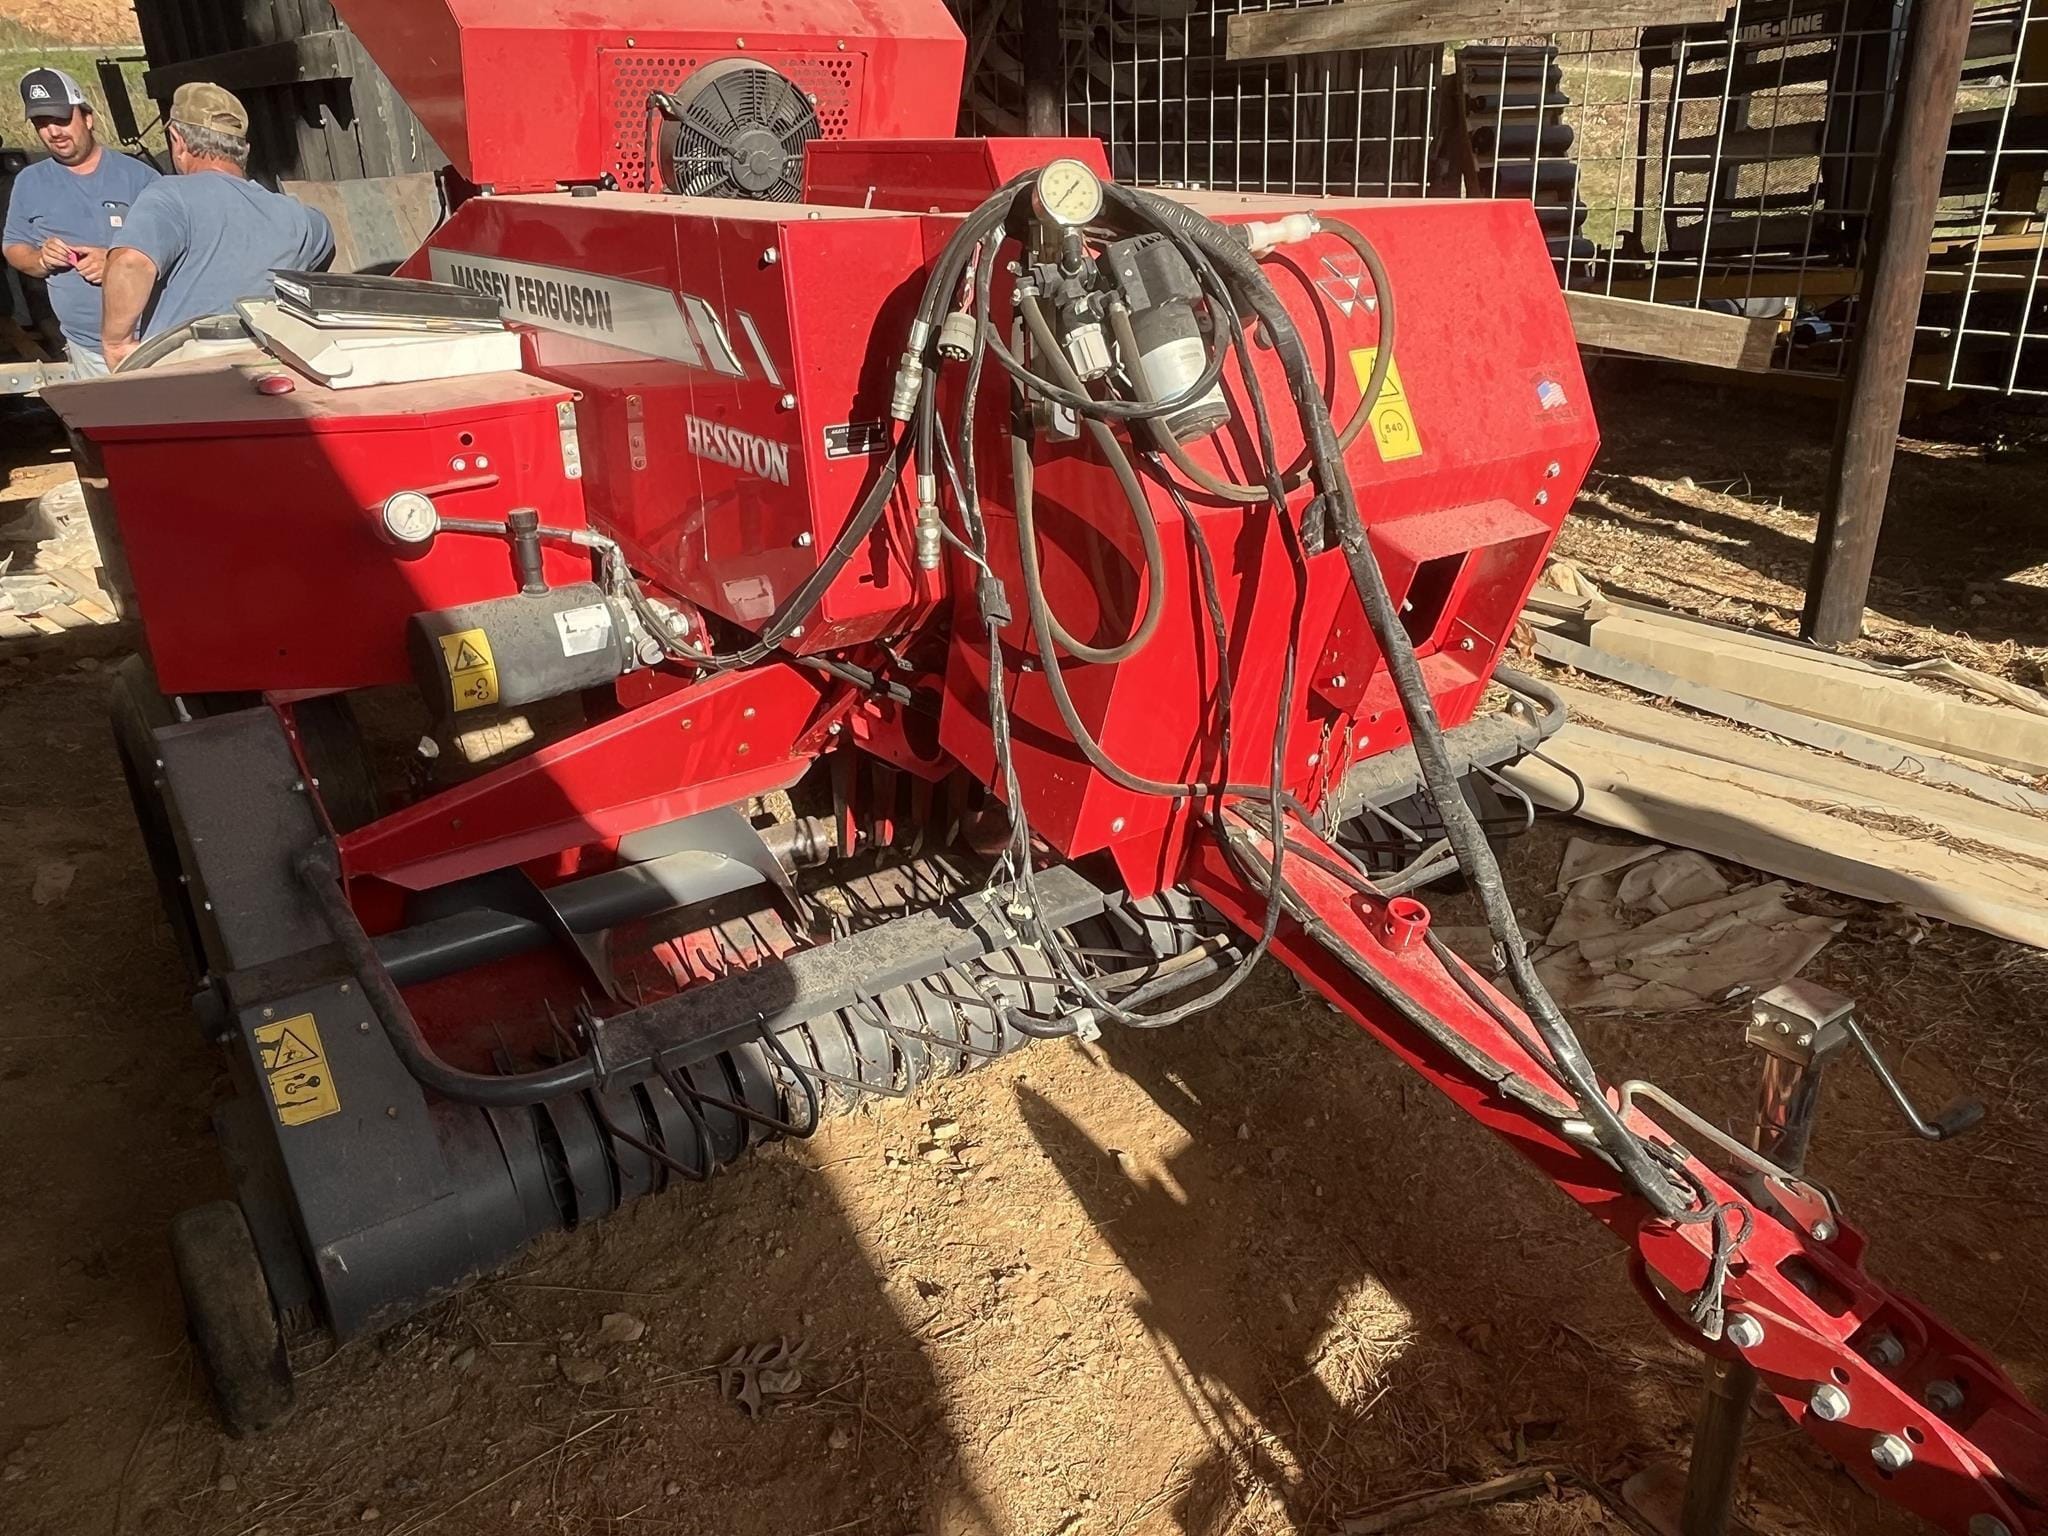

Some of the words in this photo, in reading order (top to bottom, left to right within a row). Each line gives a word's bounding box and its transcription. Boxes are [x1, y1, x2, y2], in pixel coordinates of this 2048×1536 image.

[450, 264, 512, 309] MASSEY
[514, 275, 614, 332] FERGUSON
[685, 413, 790, 486] HESSTON
[1384, 422, 1404, 434] 540
